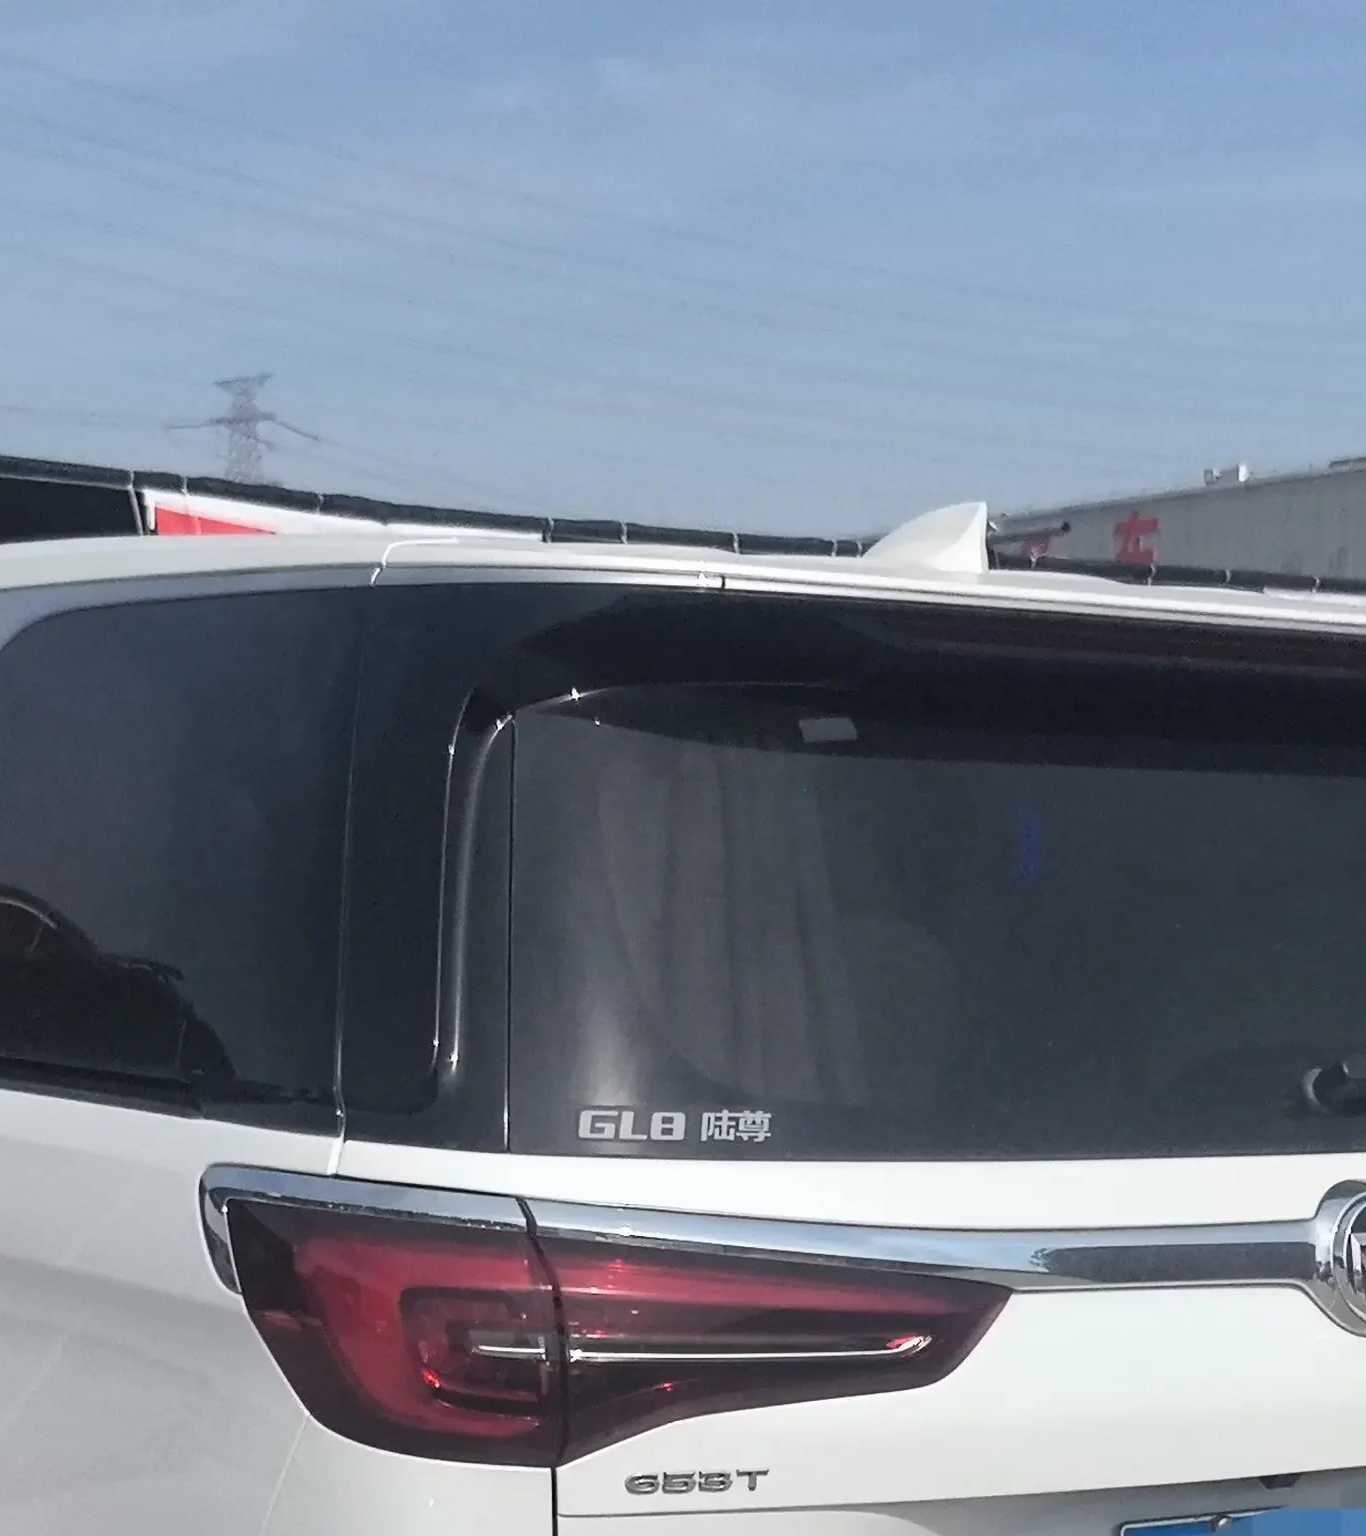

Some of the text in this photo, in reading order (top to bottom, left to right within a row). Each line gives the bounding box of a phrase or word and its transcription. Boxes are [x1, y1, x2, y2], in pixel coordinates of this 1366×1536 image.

[578, 1109, 772, 1142] GL8 陆尊
[624, 1469, 770, 1496] 653T
